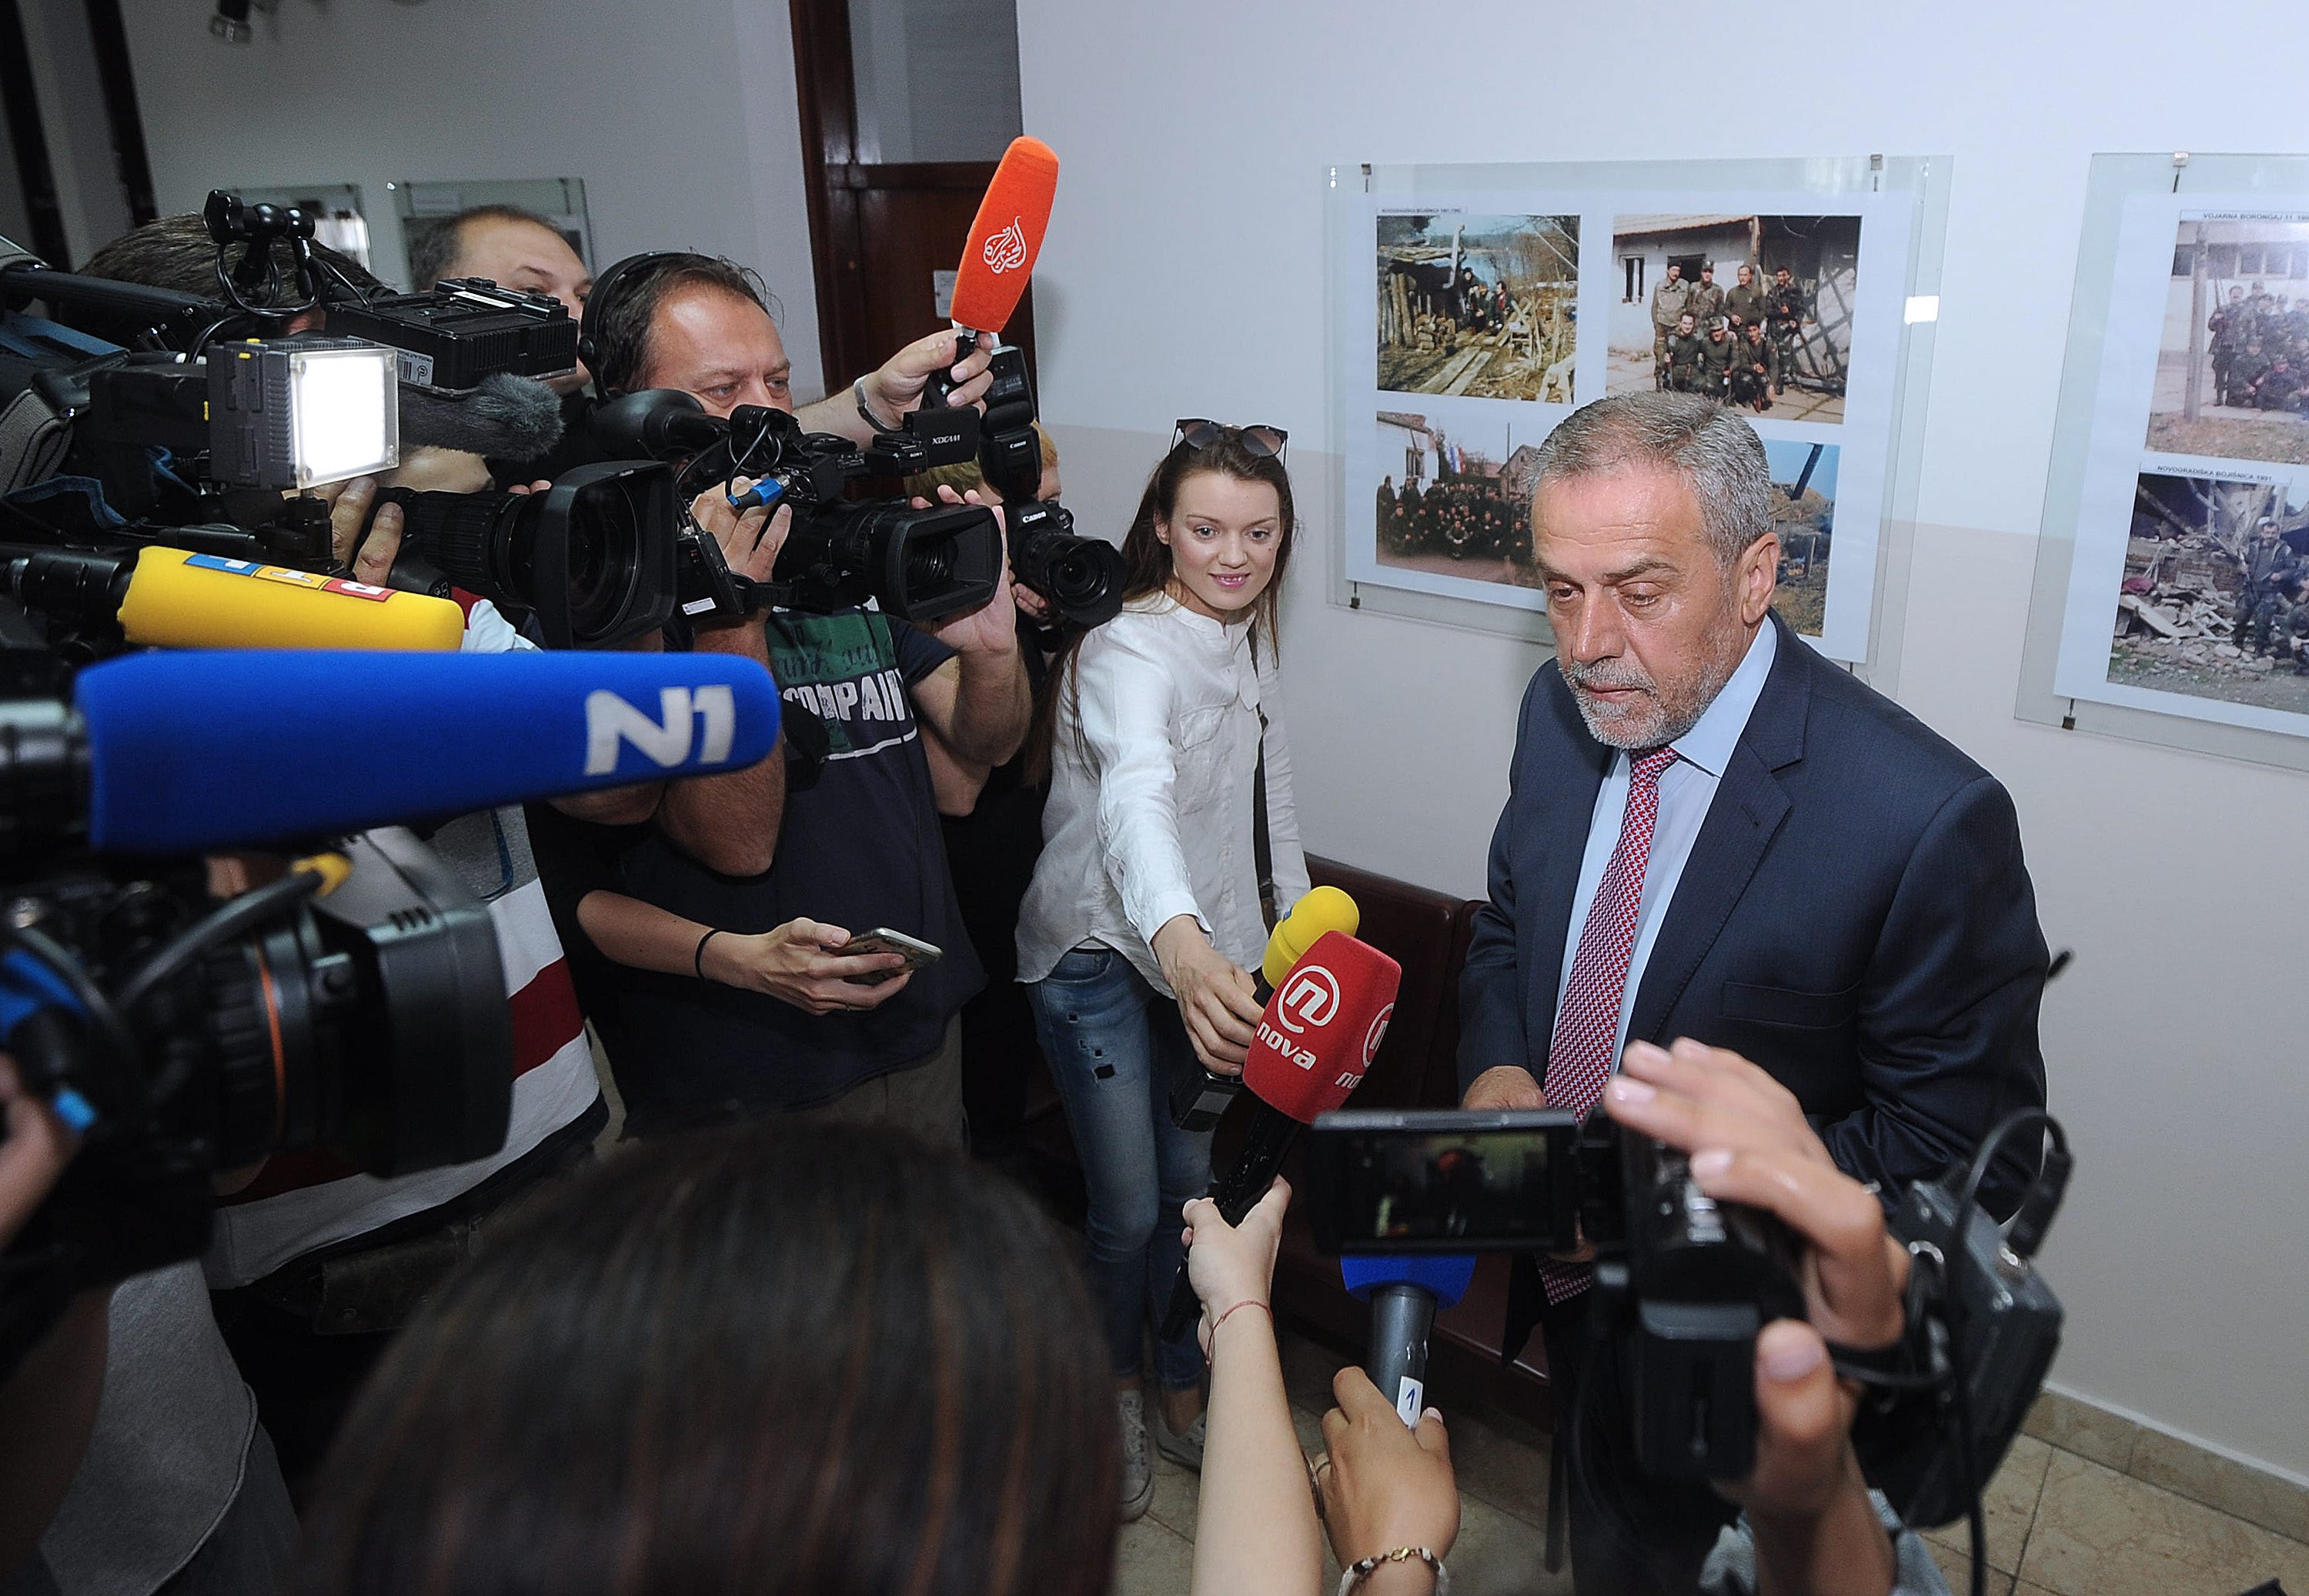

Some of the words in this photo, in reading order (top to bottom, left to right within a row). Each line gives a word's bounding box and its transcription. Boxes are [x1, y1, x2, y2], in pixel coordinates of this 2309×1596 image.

[932, 434, 961, 446] XDCAM
[1022, 511, 1047, 524] Canon
[583, 683, 736, 776] N1
[1256, 1021, 1317, 1070] nova
